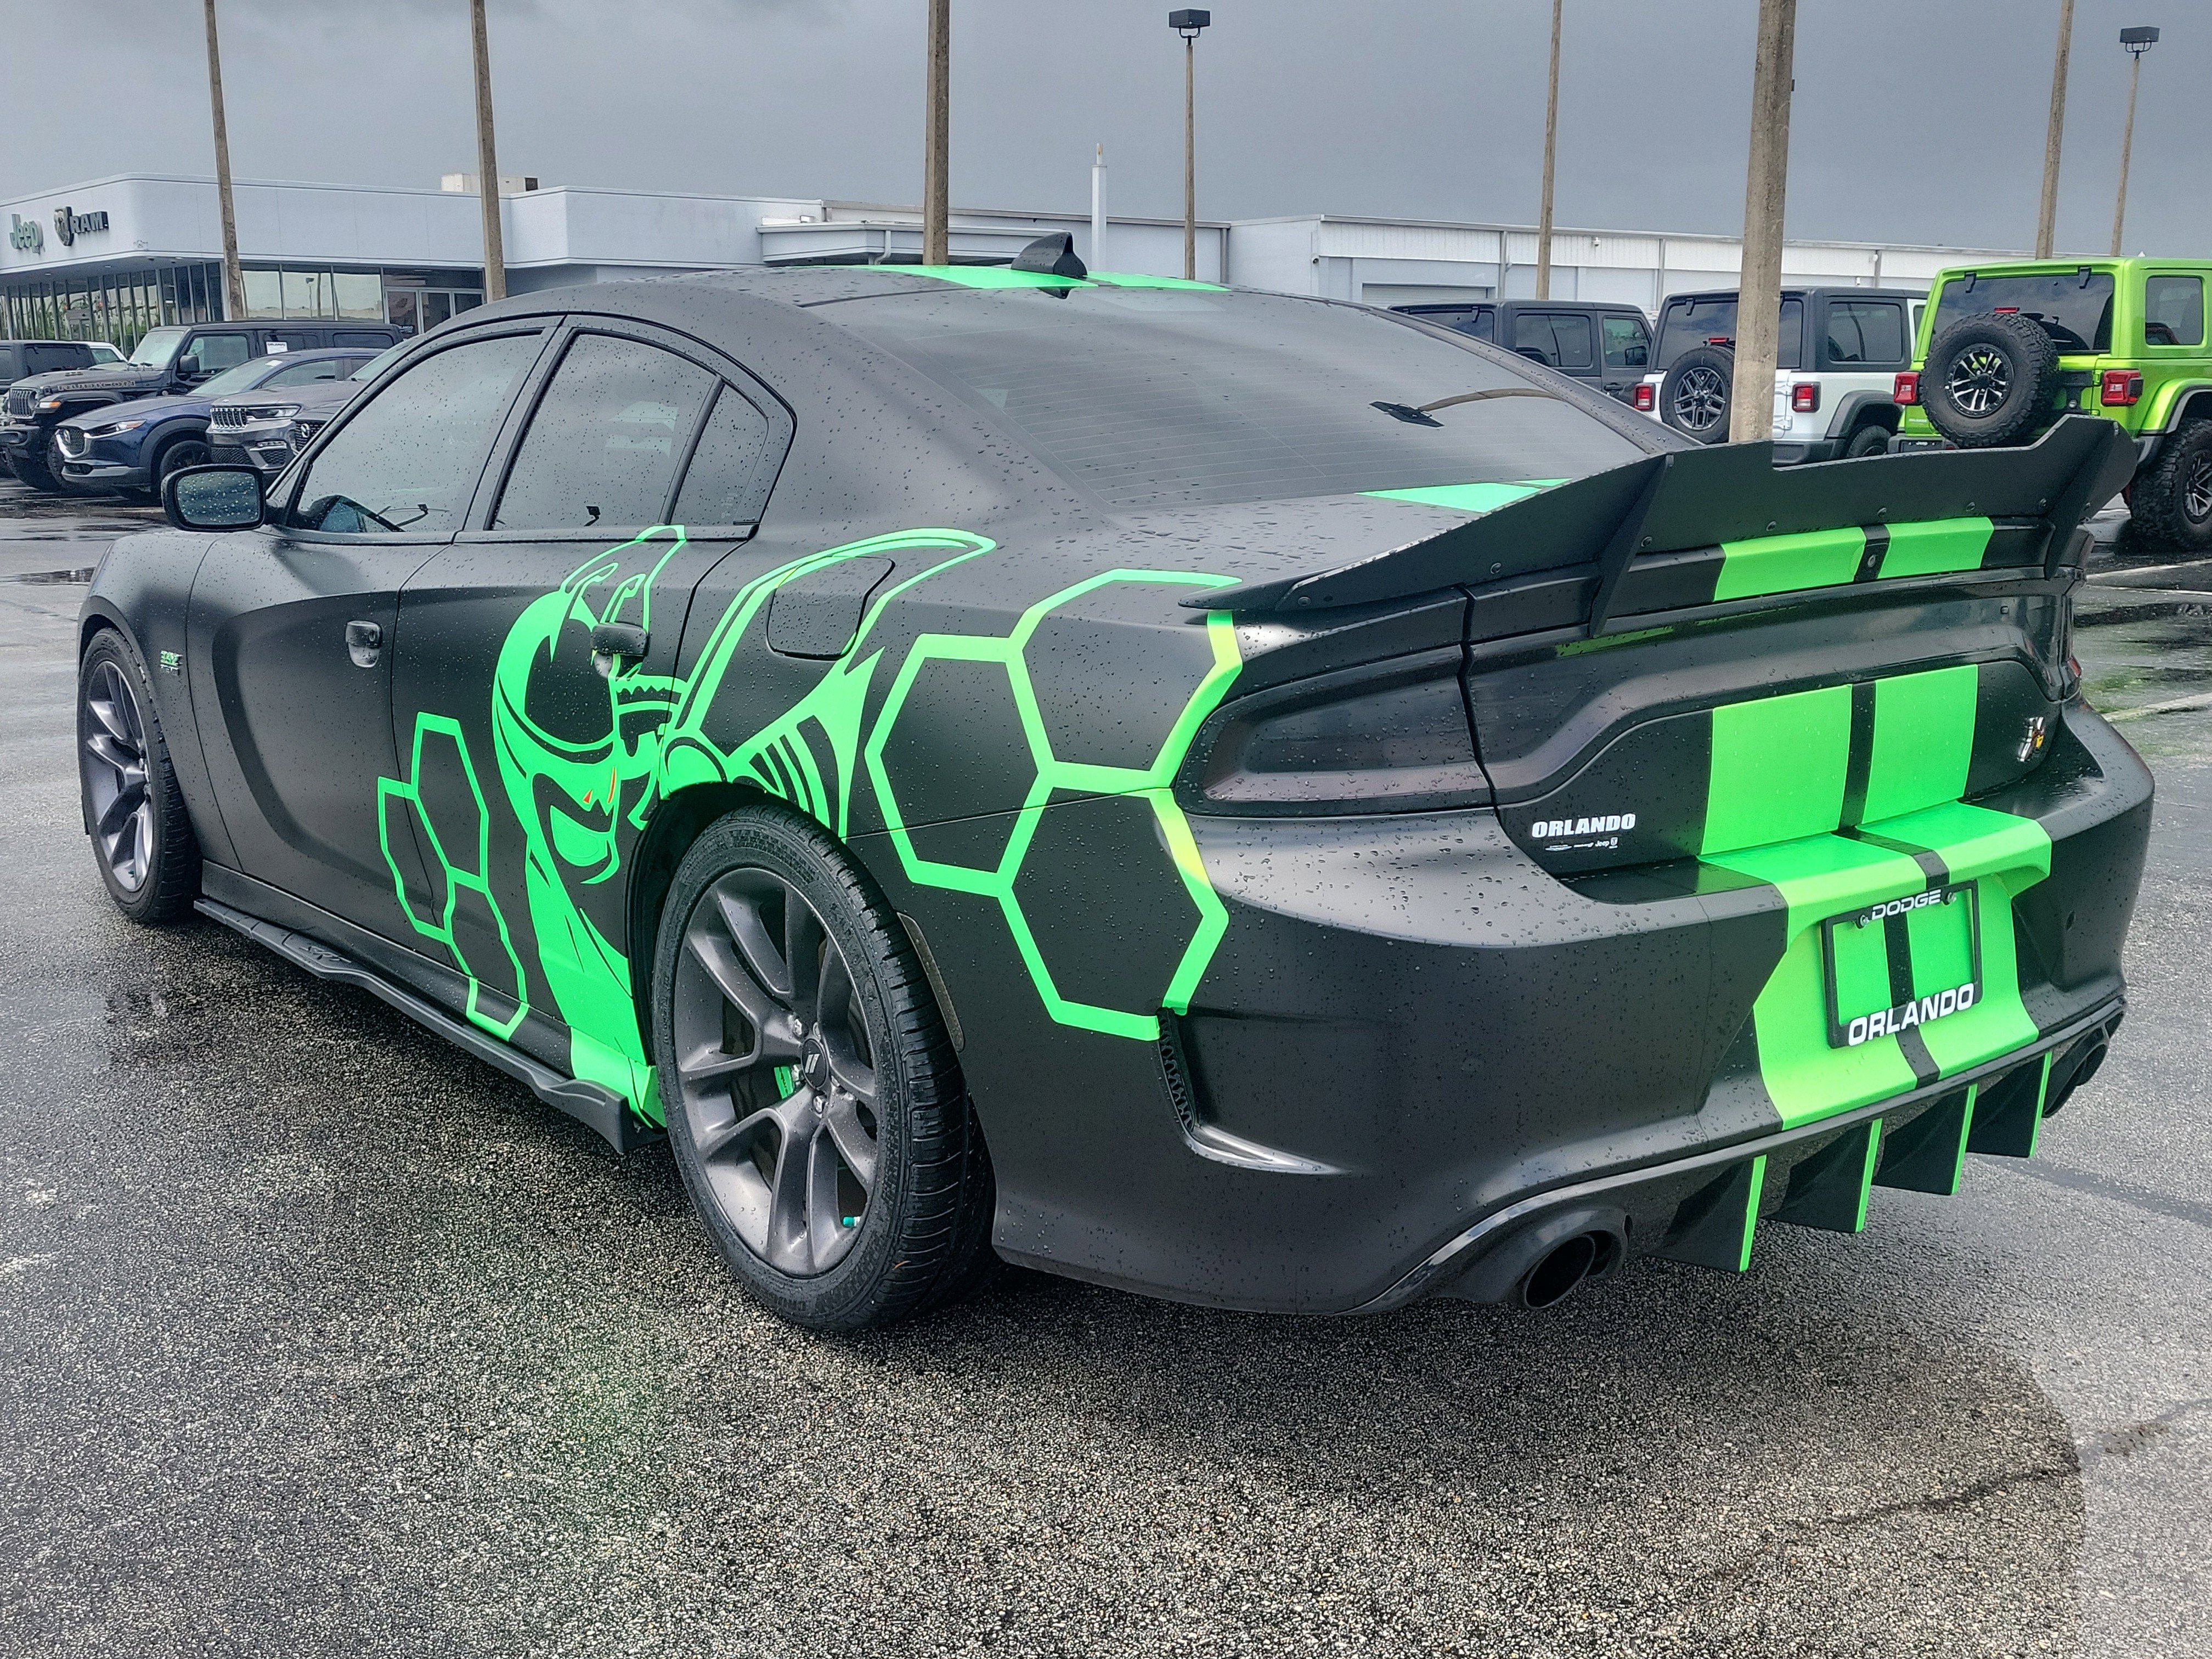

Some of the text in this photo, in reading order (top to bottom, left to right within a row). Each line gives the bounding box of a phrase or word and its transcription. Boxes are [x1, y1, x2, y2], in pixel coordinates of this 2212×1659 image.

[10, 213, 44, 254] Jeep
[69, 211, 109, 234] RAM
[58, 381, 136, 391] RUBICON
[1532, 813, 1636, 838] ORLANDO
[1871, 889, 1942, 920] DODGE
[1848, 983, 1974, 1046] ORLANDO
